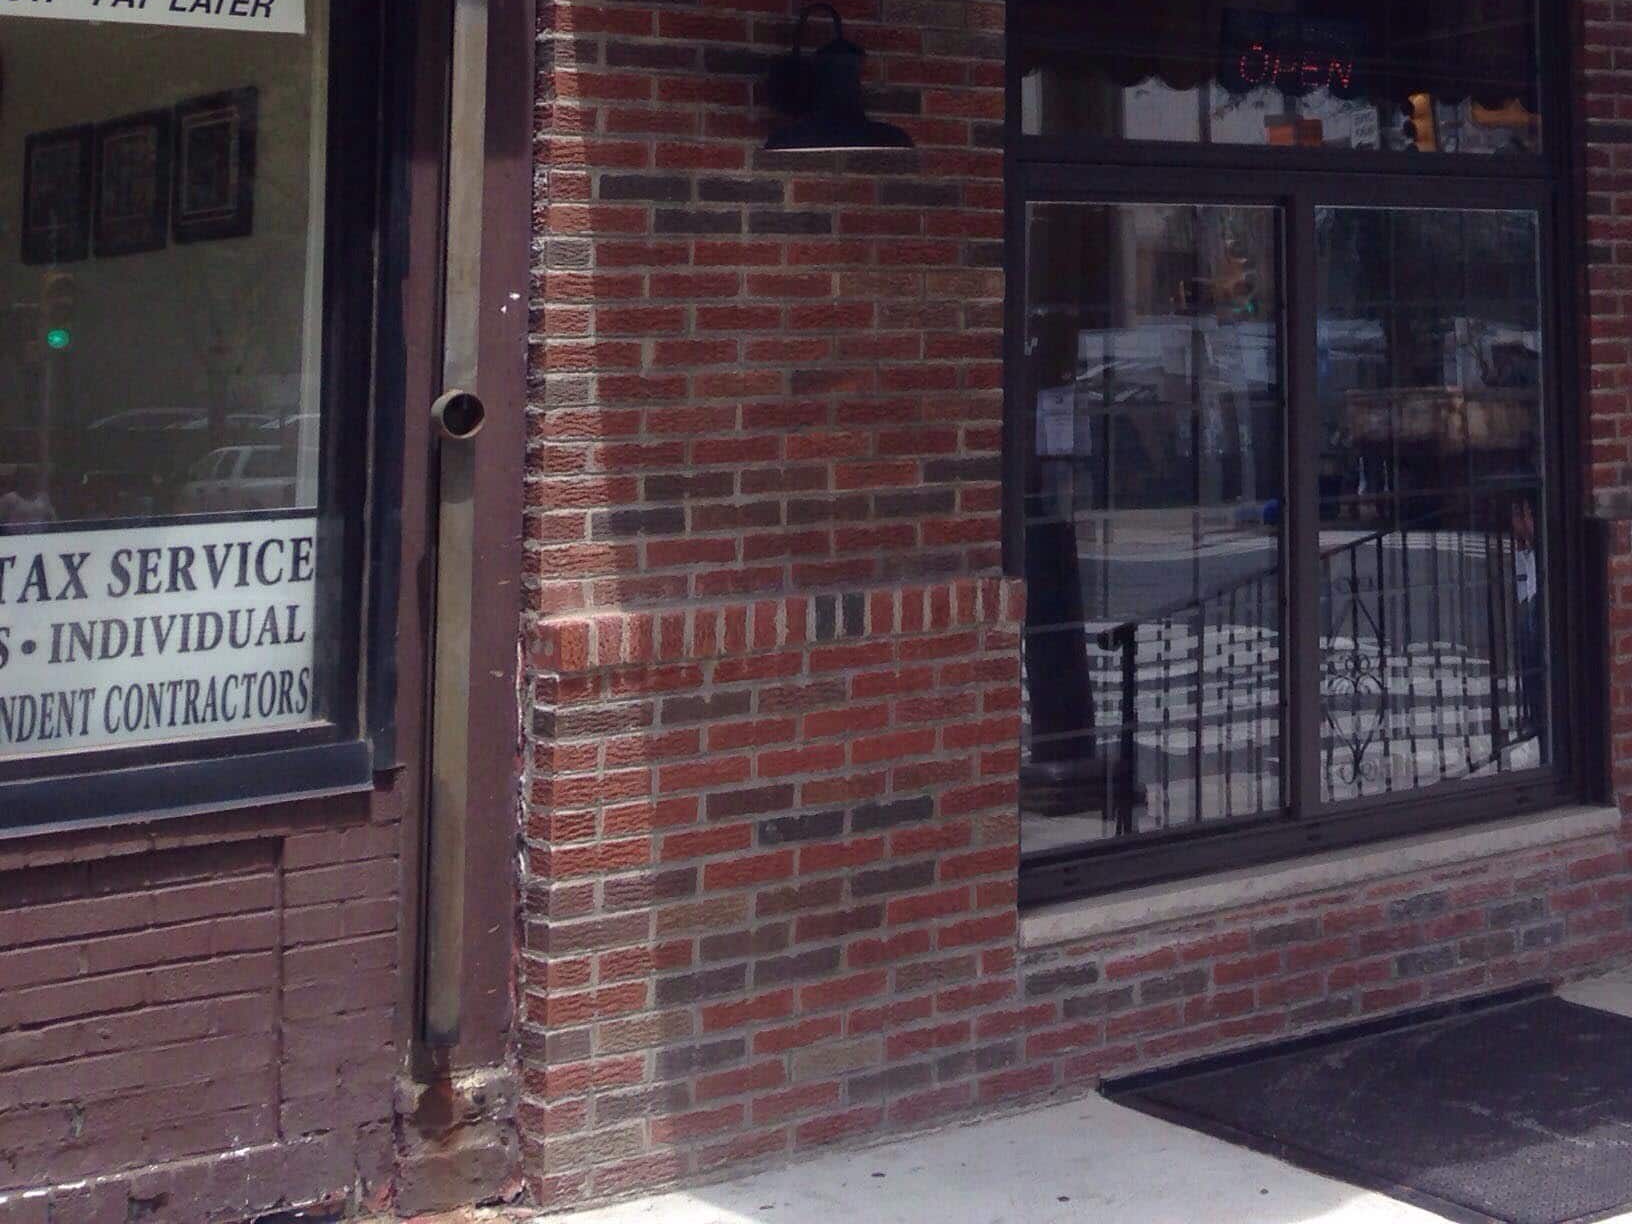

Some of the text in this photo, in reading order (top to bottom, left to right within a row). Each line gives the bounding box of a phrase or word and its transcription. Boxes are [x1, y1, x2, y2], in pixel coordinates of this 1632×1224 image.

[0, 536, 315, 606] TAX SERVICE
[48, 604, 306, 665] INDIVIDUAL
[103, 667, 311, 735] CONTRACTORS
